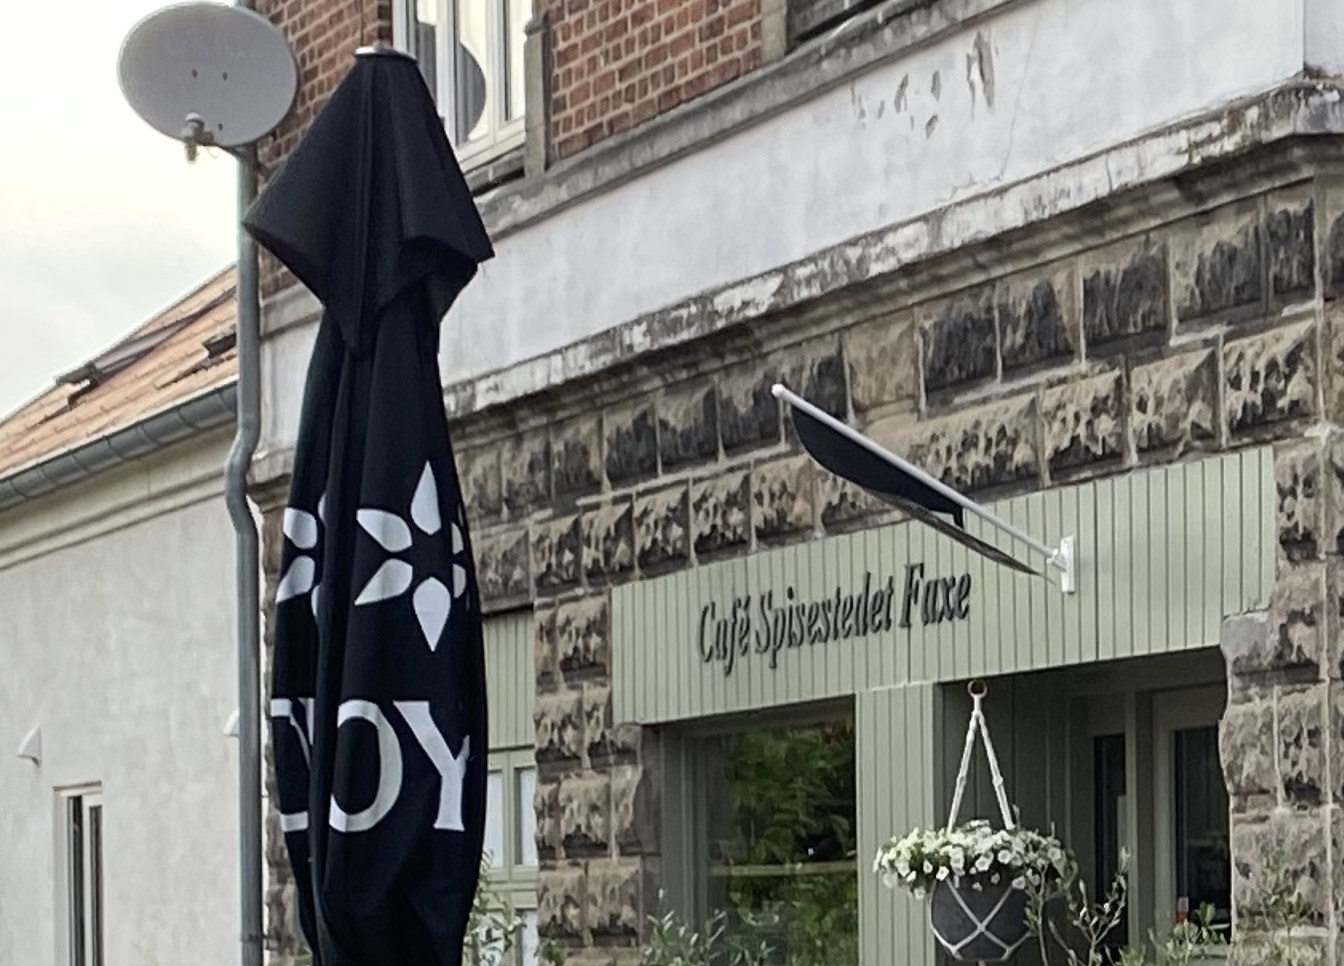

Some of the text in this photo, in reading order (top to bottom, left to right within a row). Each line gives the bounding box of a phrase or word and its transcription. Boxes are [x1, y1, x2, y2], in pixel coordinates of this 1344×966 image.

[700, 562, 972, 677] Café Spisestedet Faxe
